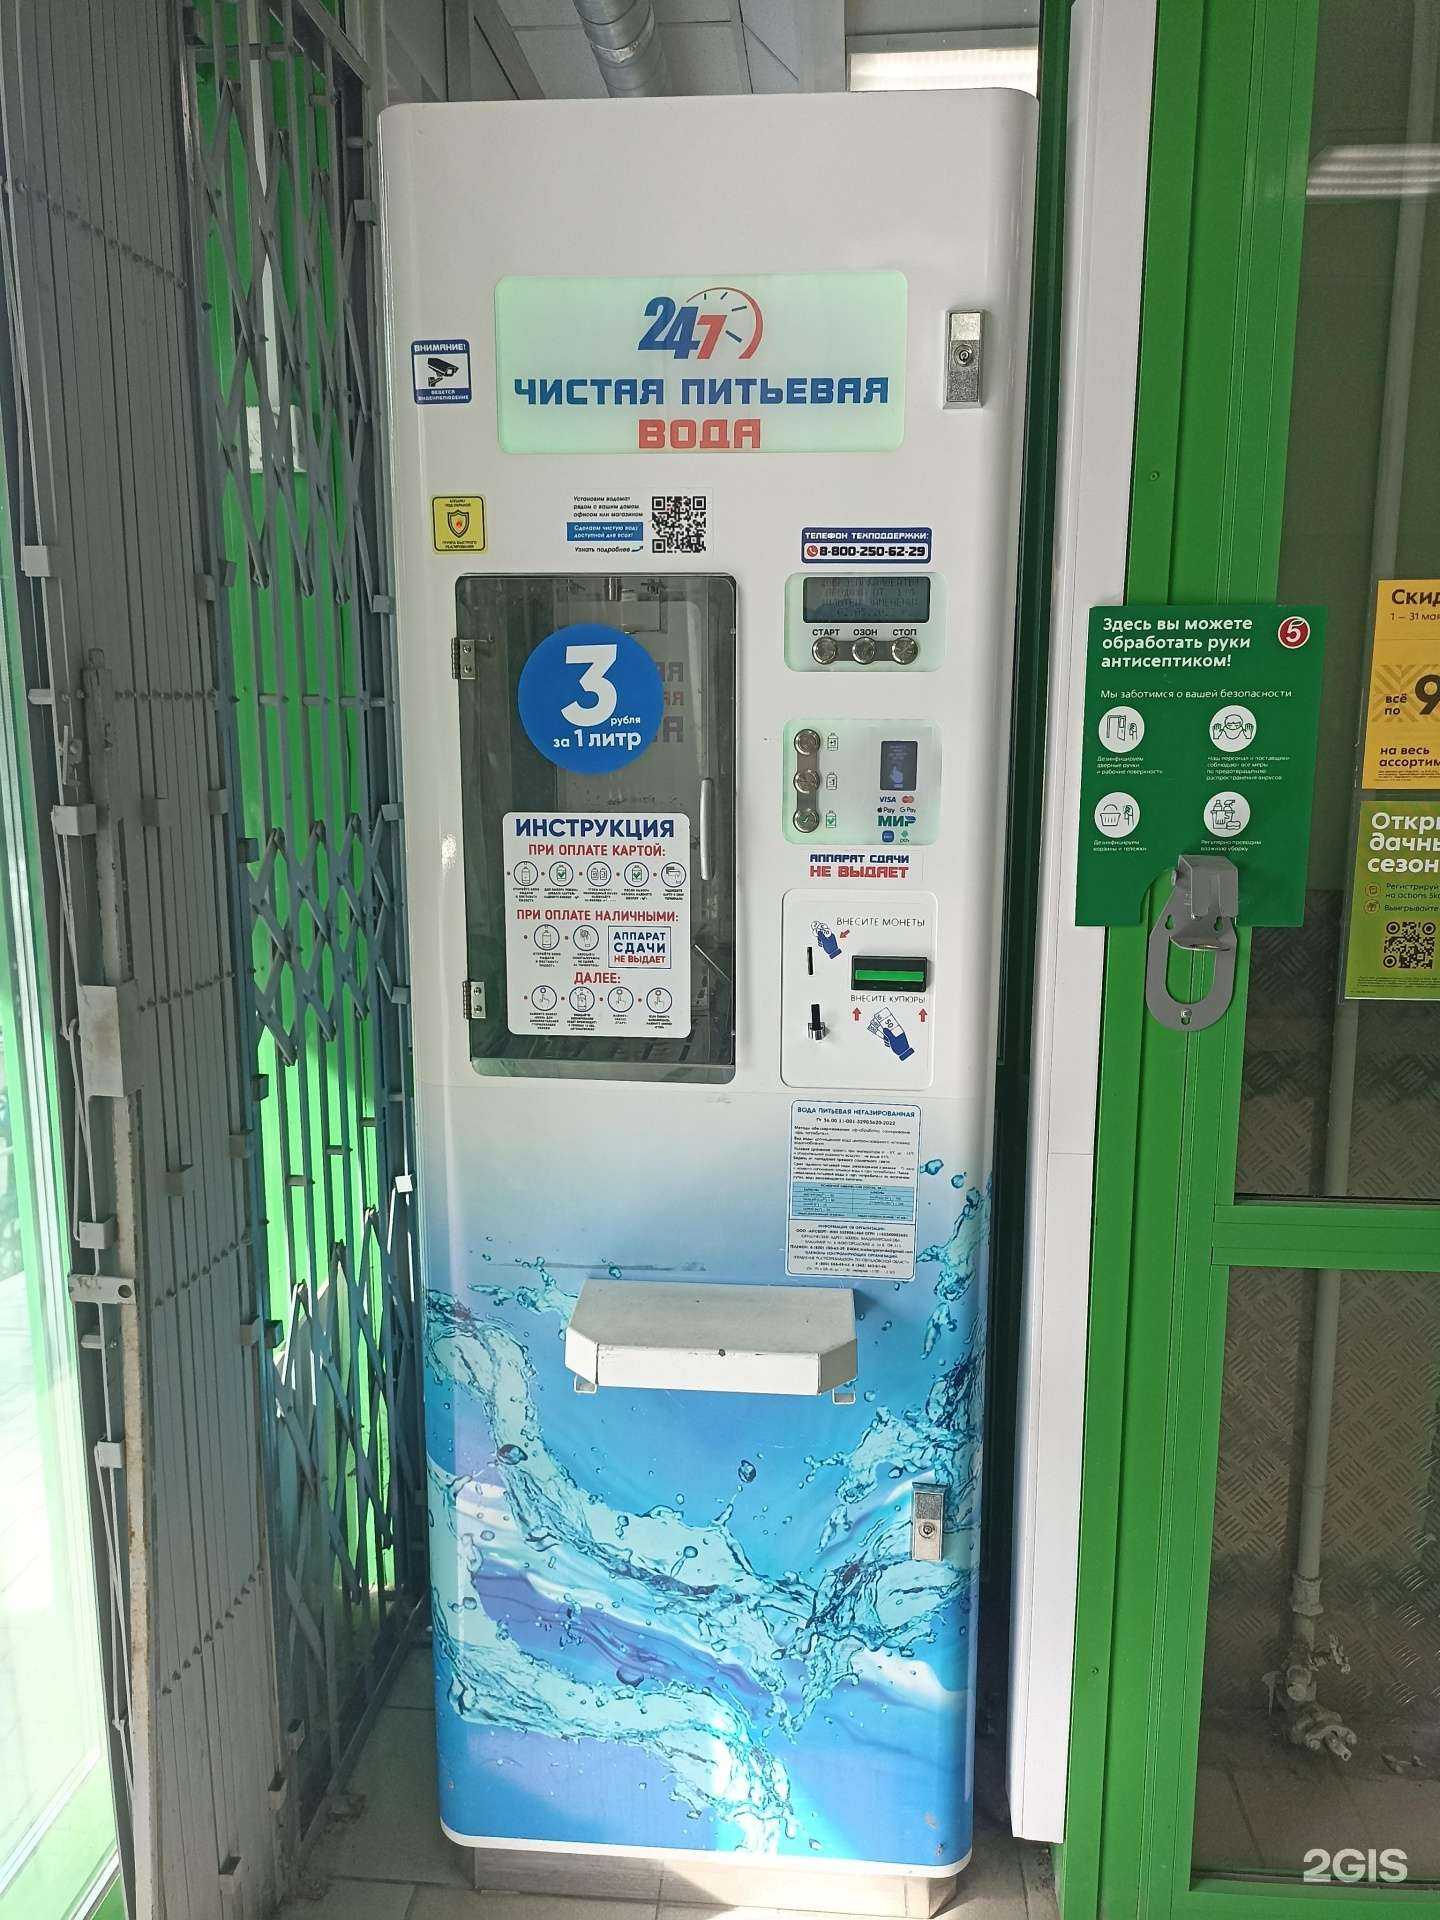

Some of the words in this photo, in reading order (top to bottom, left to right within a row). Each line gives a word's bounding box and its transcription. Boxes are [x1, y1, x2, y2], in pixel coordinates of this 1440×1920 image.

[638, 296, 728, 359] 247
[414, 343, 466, 353] ВНИМАНИЕ!
[514, 378, 664, 405] ЧИСТАЯ
[681, 377, 889, 405] ПИТЬЕВАЯ
[638, 418, 761, 449] ВОДА
[819, 546, 926, 557] 8-800-250-62-29
[1389, 612, 1395, 621] 1
[1409, 612, 1419, 621] 31
[1103, 618, 1152, 632] Здесь
[1157, 619, 1180, 630] вы
[1184, 618, 1253, 630] можете
[812, 628, 840, 636] СТАРТ
[853, 628, 878, 636] ОЗОН
[892, 628, 917, 636] СТОП
[1102, 636, 1203, 652] обработать
[1207, 637, 1251, 651] руки
[1101, 654, 1232, 668] антисептиком!
[560, 643, 618, 727] 3
[610, 715, 641, 727] рубля
[1100, 690, 1119, 699] Мы
[1120, 690, 1174, 699] заботимся
[1186, 688, 1218, 698] вашей
[1220, 688, 1292, 698] безопасности
[1385, 693, 1407, 704] всё
[1384, 707, 1401, 716] по
[553, 735, 570, 748] за
[573, 728, 584, 747] 1
[588, 730, 642, 751] литр
[1380, 747, 1397, 755] на
[1401, 747, 1430, 755] весь
[884, 807, 896, 815] Pay
[877, 815, 917, 827] МИР
[515, 818, 675, 841] ИНСТРУКЦИЯ
[528, 844, 555, 855] ПРИ
[558, 844, 608, 856] ОПЛАТЕ
[612, 843, 666, 857] КАРТОЙ:
[810, 854, 866, 863] АППАРАТ
[869, 854, 910, 864] СДАЧИ
[1367, 857, 1439, 873] сезон
[810, 865, 832, 877] НЕ
[838, 866, 909, 878] ВЫДАЕТ
[516, 909, 541, 920] ПРИ
[545, 910, 591, 921] ОПЛАТЕ
[595, 910, 679, 922] НАЛИЧНЫМИ:
[836, 917, 879, 926] ВНЕСИТЕ
[882, 918, 926, 927] МОНЕТЫ
[613, 931, 667, 941] АППАРАТ
[613, 942, 666, 954] СДАЧИ
[613, 955, 626, 963] НЕ
[627, 955, 667, 965] ВЫДАЕТ
[573, 972, 621, 985] ДАЛЕЕ:
[850, 994, 887, 1003] ВНЕСИТЕ
[889, 995, 926, 1004] КУПЮРЫ
[884, 1018, 894, 1029] 50
[853, 1110, 915, 1118] НЕГАЗИРОВАННАЯ
